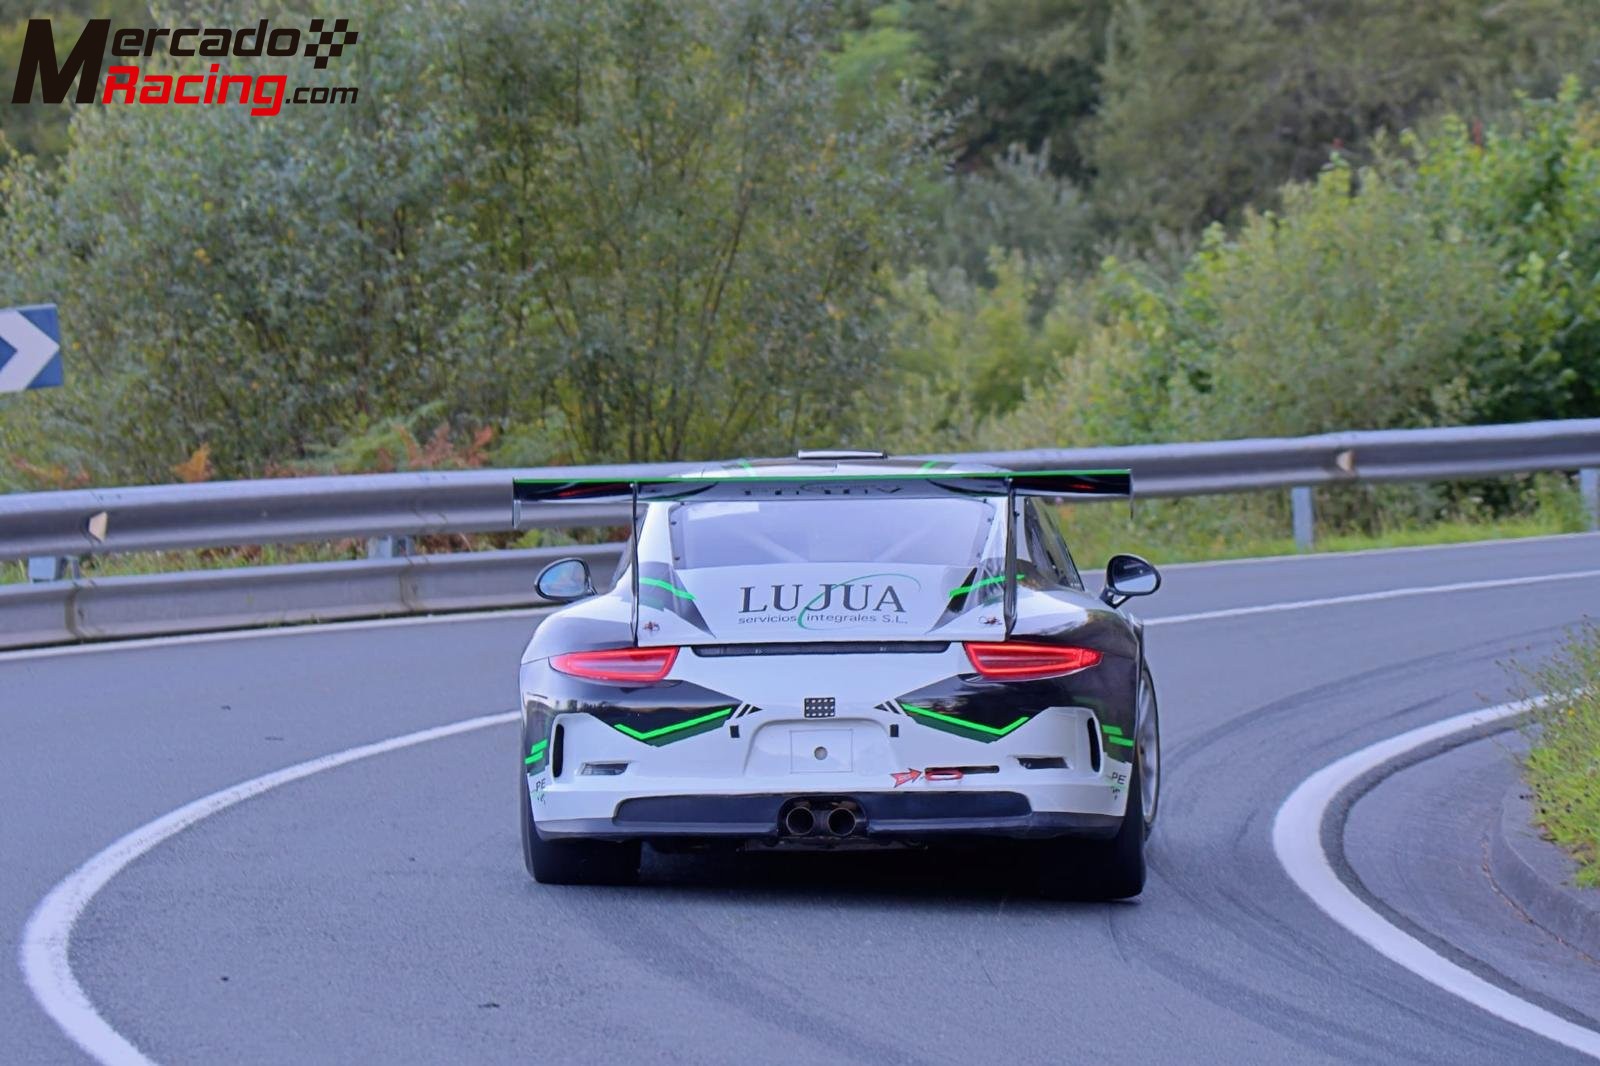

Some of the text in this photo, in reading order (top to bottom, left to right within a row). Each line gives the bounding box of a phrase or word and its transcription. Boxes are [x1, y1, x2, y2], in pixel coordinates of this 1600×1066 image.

[738, 583, 906, 613] LUJUA
[738, 613, 798, 624] servicios
[806, 613, 877, 624] integrales
